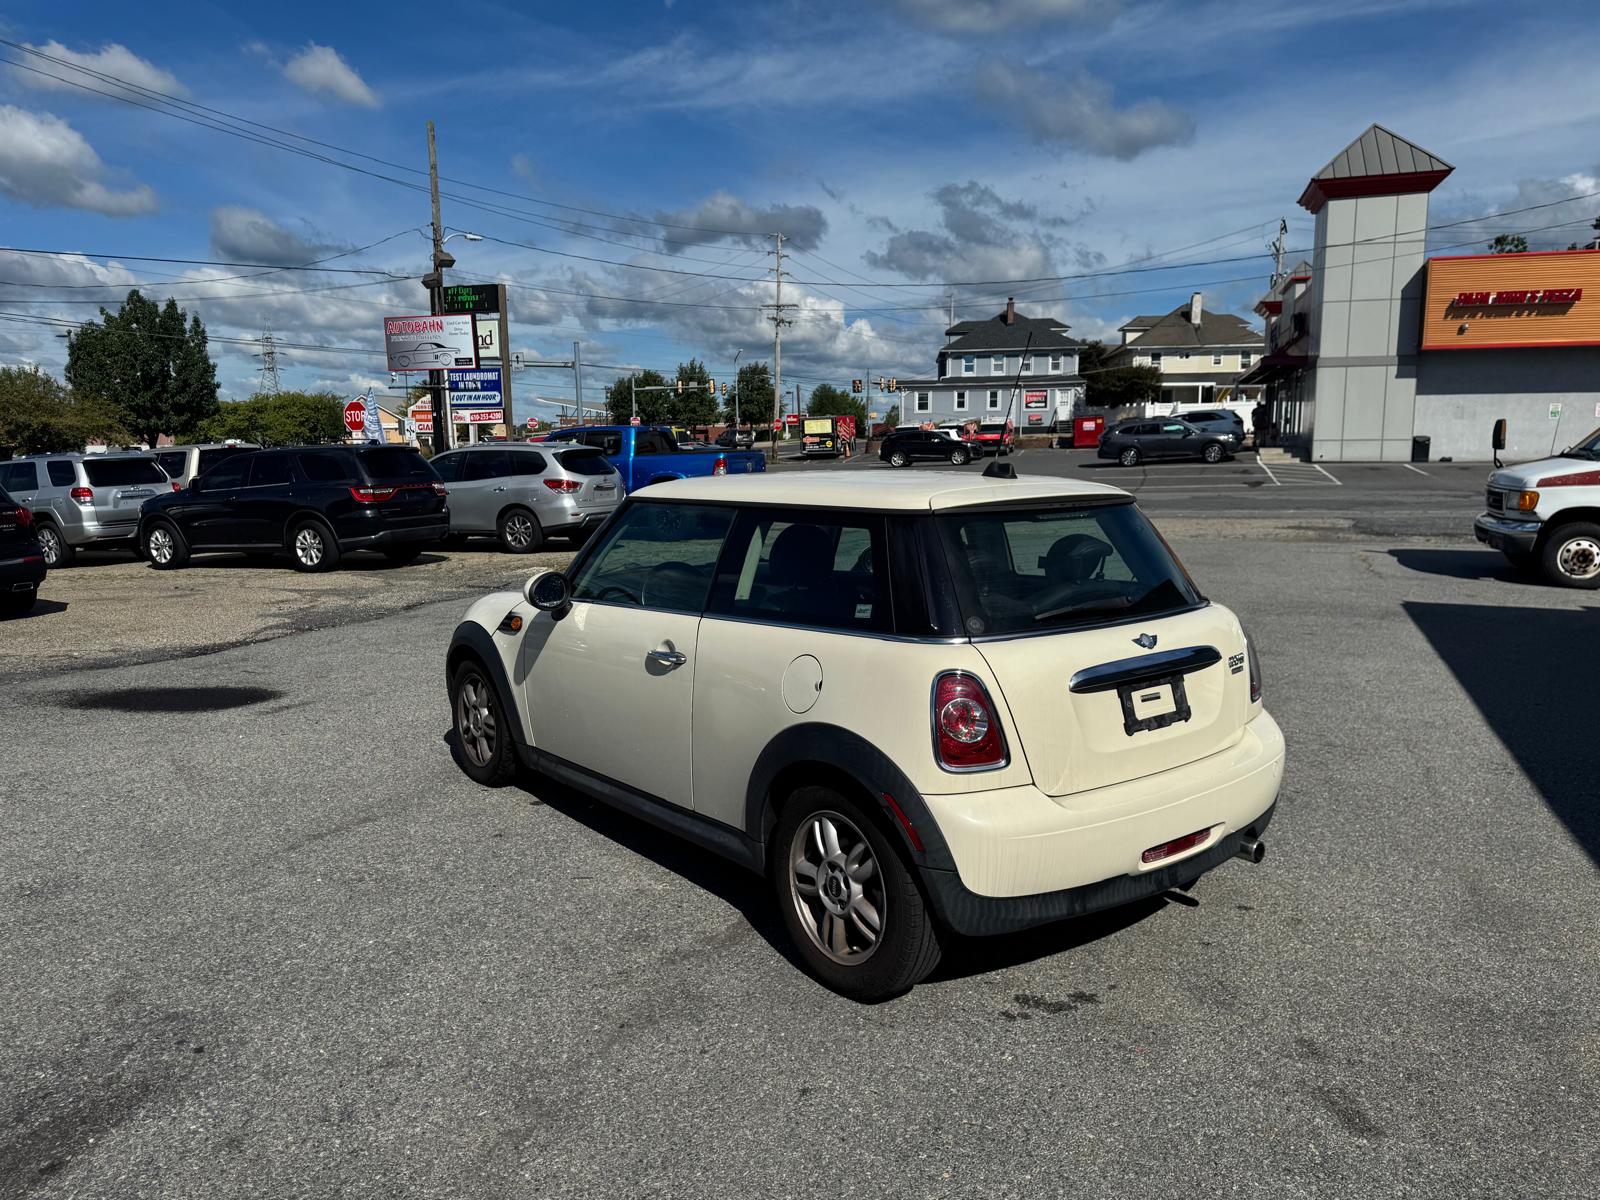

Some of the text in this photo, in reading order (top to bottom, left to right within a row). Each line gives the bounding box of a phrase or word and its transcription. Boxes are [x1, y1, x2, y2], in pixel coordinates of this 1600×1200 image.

[387, 320, 443, 334] AUTOBAHN
[463, 372, 499, 381] LAUNDROMAT
[345, 410, 366, 423] STOP
[470, 412, 502, 421] 610-253-4200
